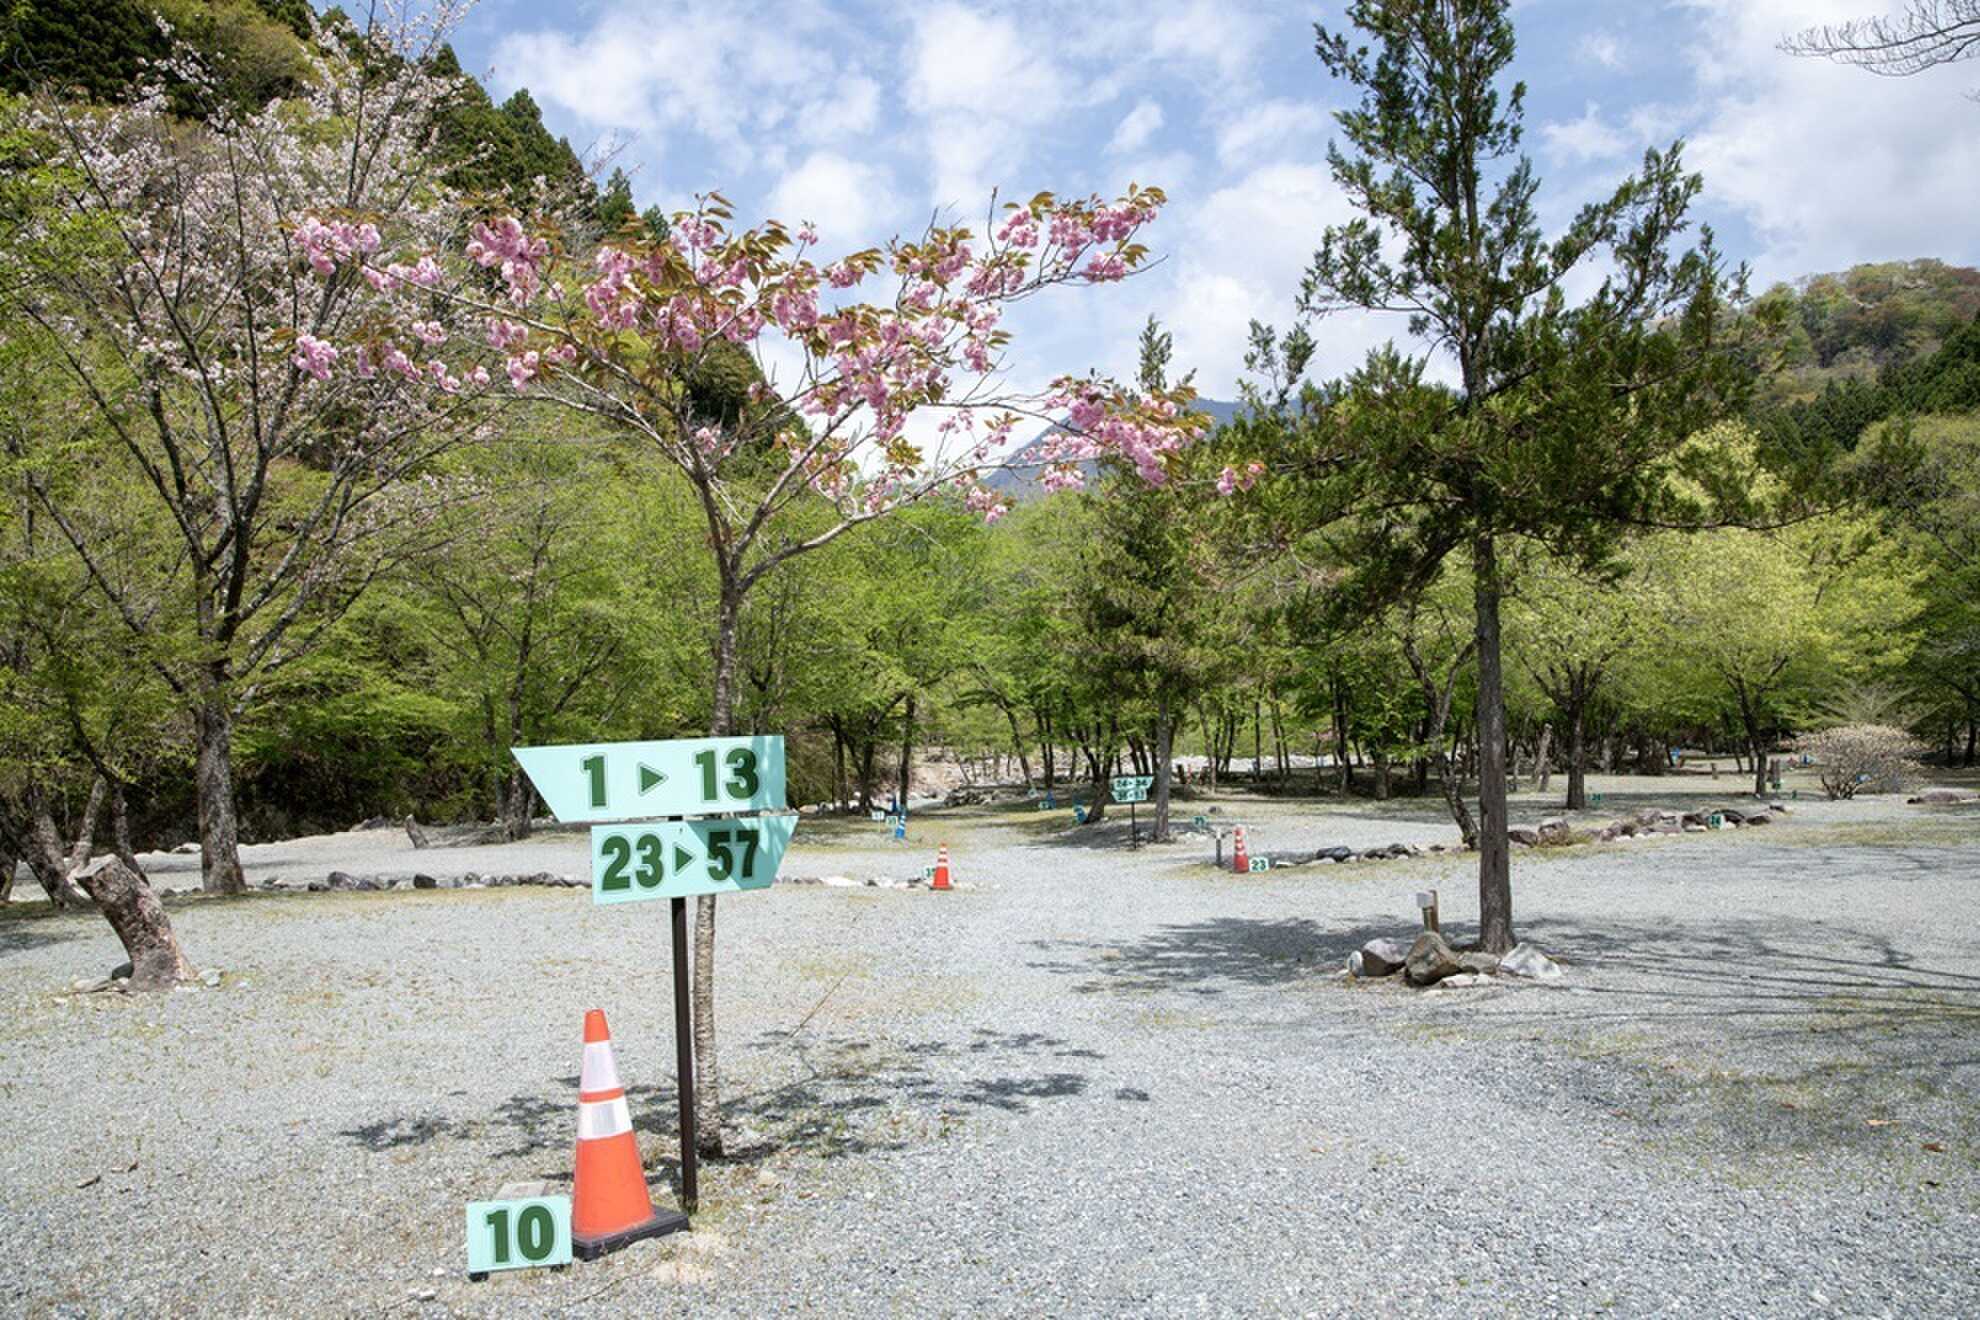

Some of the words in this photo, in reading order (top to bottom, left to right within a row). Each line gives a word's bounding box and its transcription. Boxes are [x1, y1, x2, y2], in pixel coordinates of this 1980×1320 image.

[582, 755, 607, 807] 1
[695, 749, 759, 801] 13
[601, 834, 664, 890] 23
[707, 829, 760, 881] 57
[486, 1205, 555, 1263] 10
